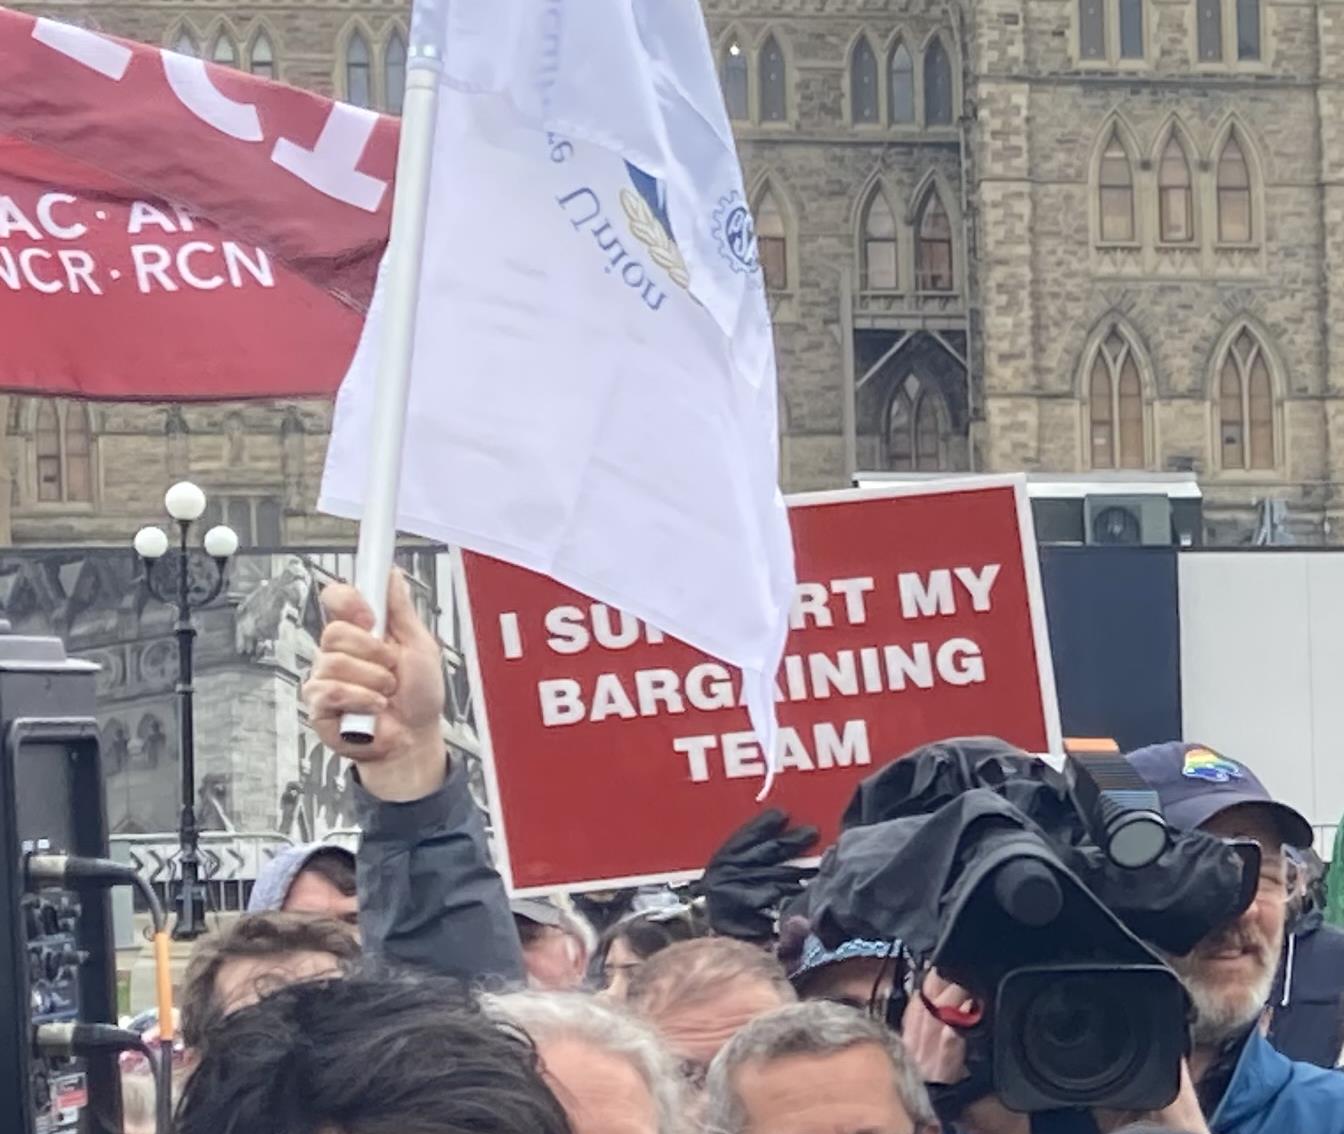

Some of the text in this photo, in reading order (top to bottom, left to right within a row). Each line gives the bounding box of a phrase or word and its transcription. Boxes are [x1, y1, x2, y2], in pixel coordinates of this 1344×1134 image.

[130, 241, 275, 293] RCN
[499, 612, 523, 659] I
[898, 564, 1001, 619] MY
[538, 638, 986, 727] BARGINING
